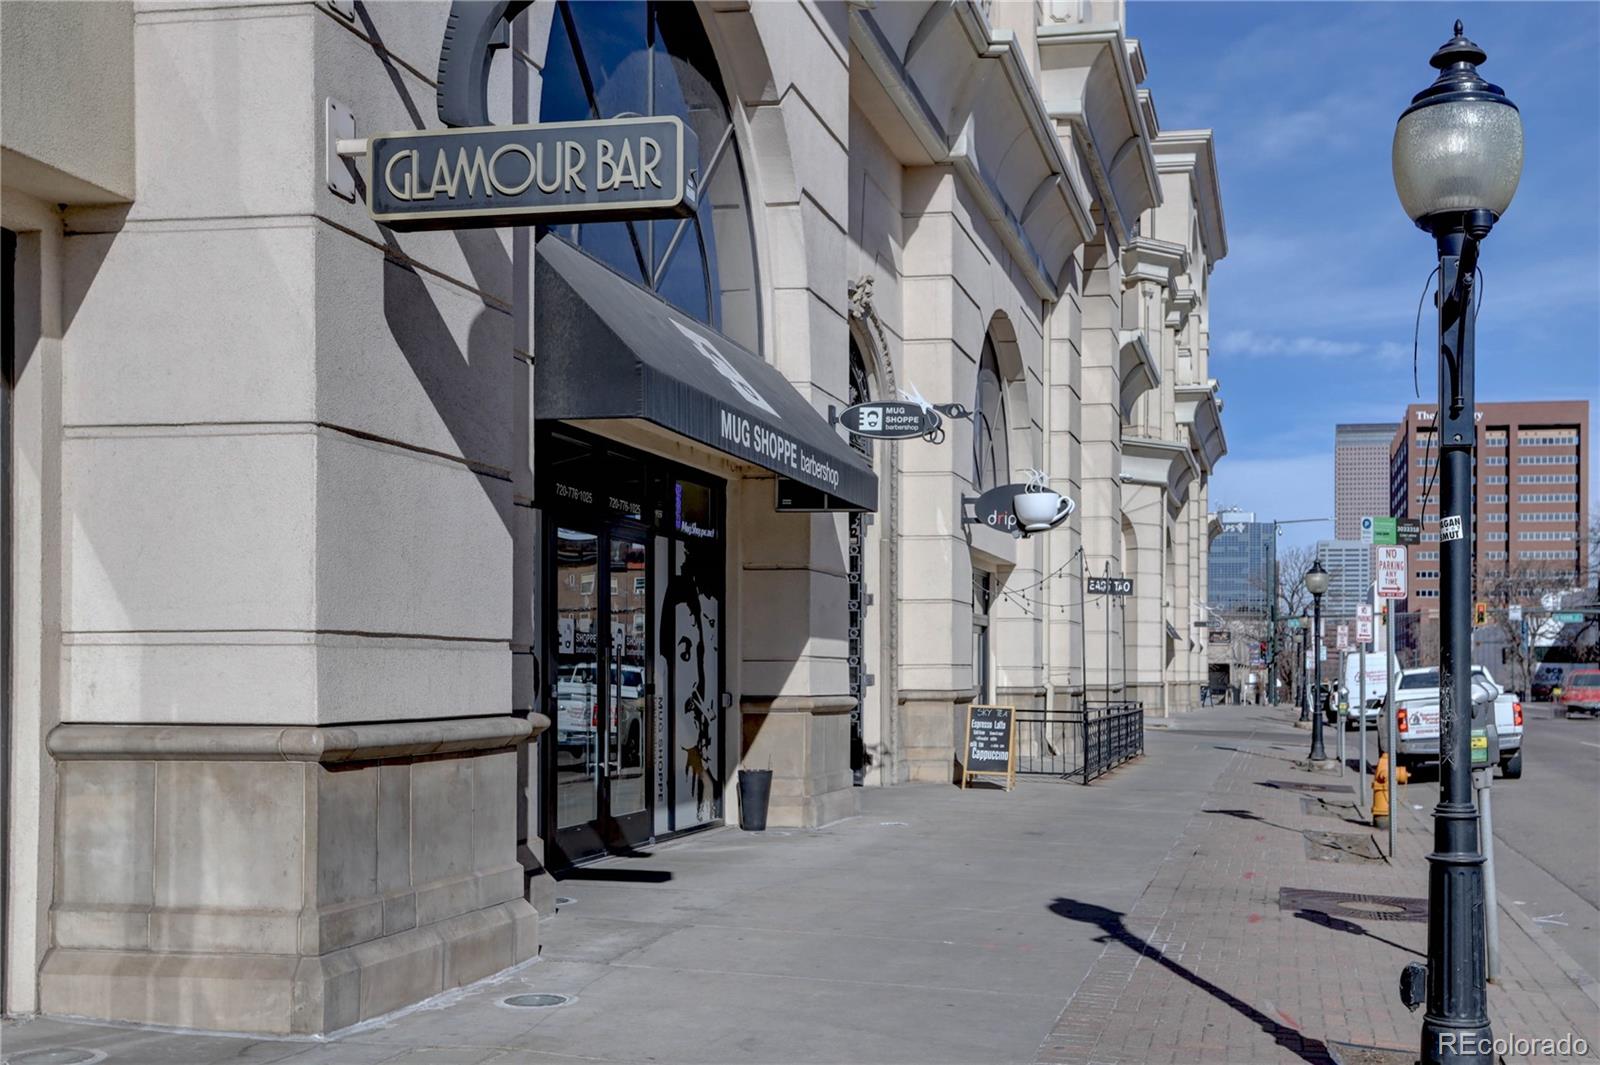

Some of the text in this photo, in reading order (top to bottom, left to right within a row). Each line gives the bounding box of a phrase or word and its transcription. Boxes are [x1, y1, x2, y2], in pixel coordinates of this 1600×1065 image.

[384, 136, 663, 201] GLAMOUR BAR
[1416, 411, 1435, 420] The
[720, 409, 840, 491] MUG SHOPPE barbershop
[987, 509, 1017, 530] drip
[1386, 549, 1397, 558] NO
[1379, 561, 1404, 570] PARKING
[972, 747, 1009, 761] Cappuccino
